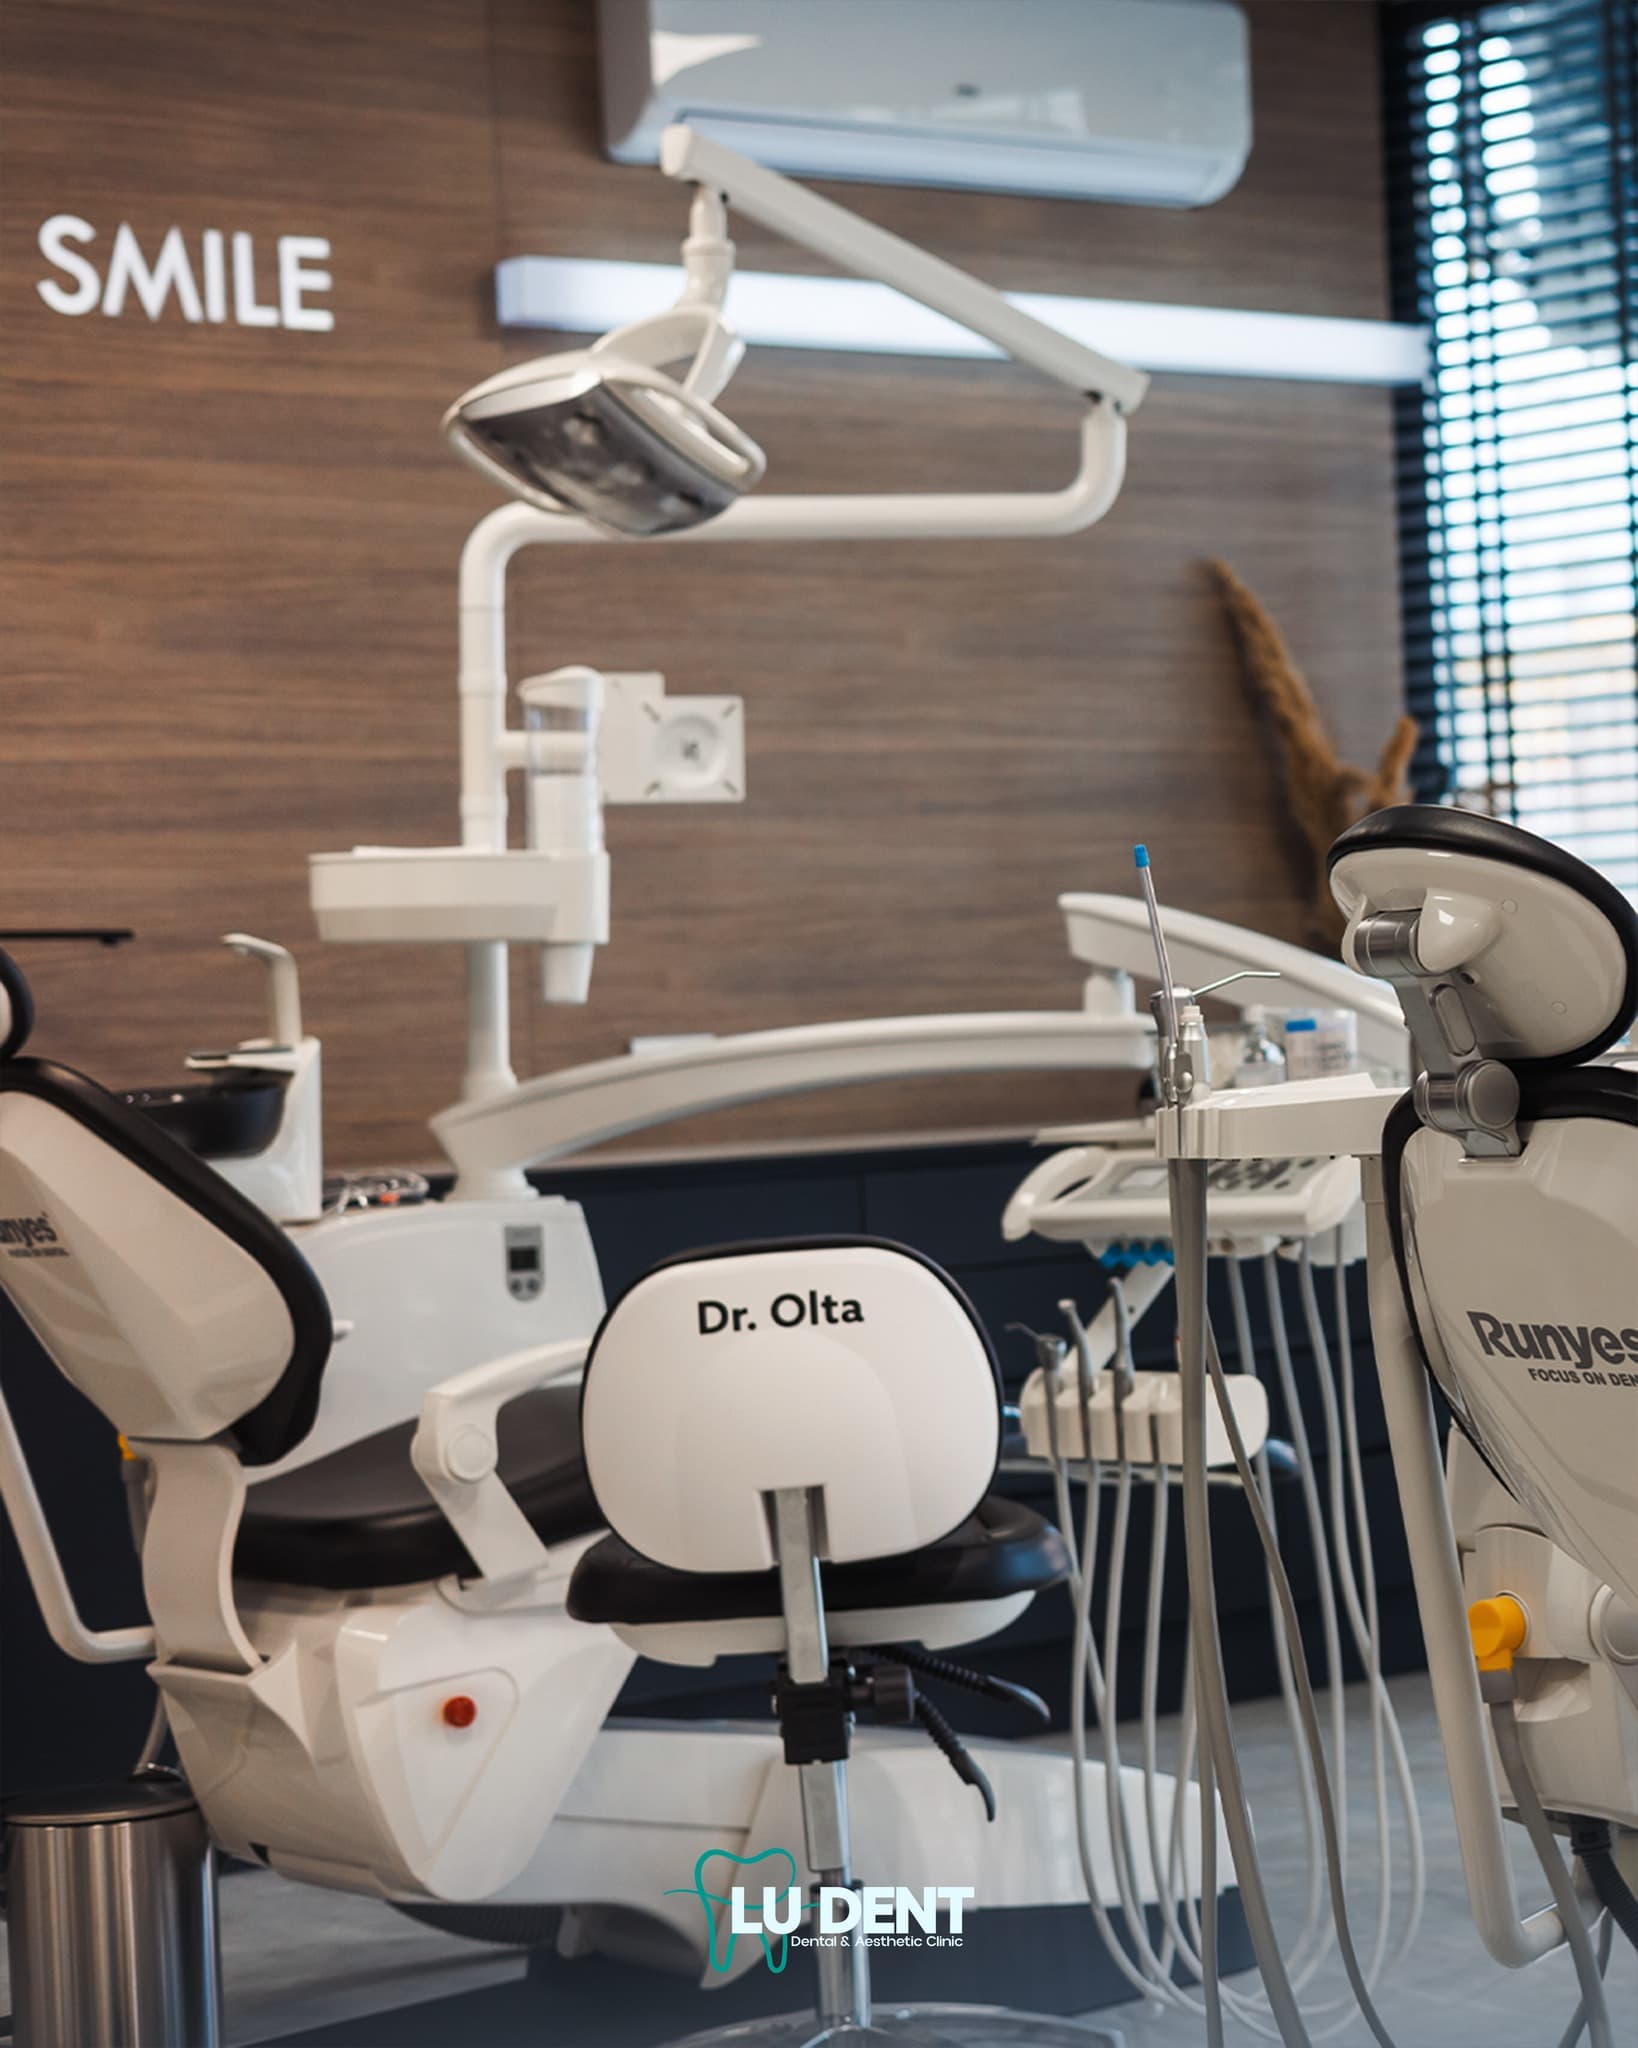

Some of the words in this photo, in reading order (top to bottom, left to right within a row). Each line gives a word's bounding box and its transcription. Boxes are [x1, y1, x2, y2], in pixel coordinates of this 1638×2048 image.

[37, 214, 335, 332] SMILE
[697, 1300, 757, 1336] Dr.
[770, 1289, 865, 1328] Olta
[1466, 1310, 1638, 1369] Runyes
[1528, 1367, 1581, 1384] FOCUS
[1582, 1371, 1607, 1385] ON
